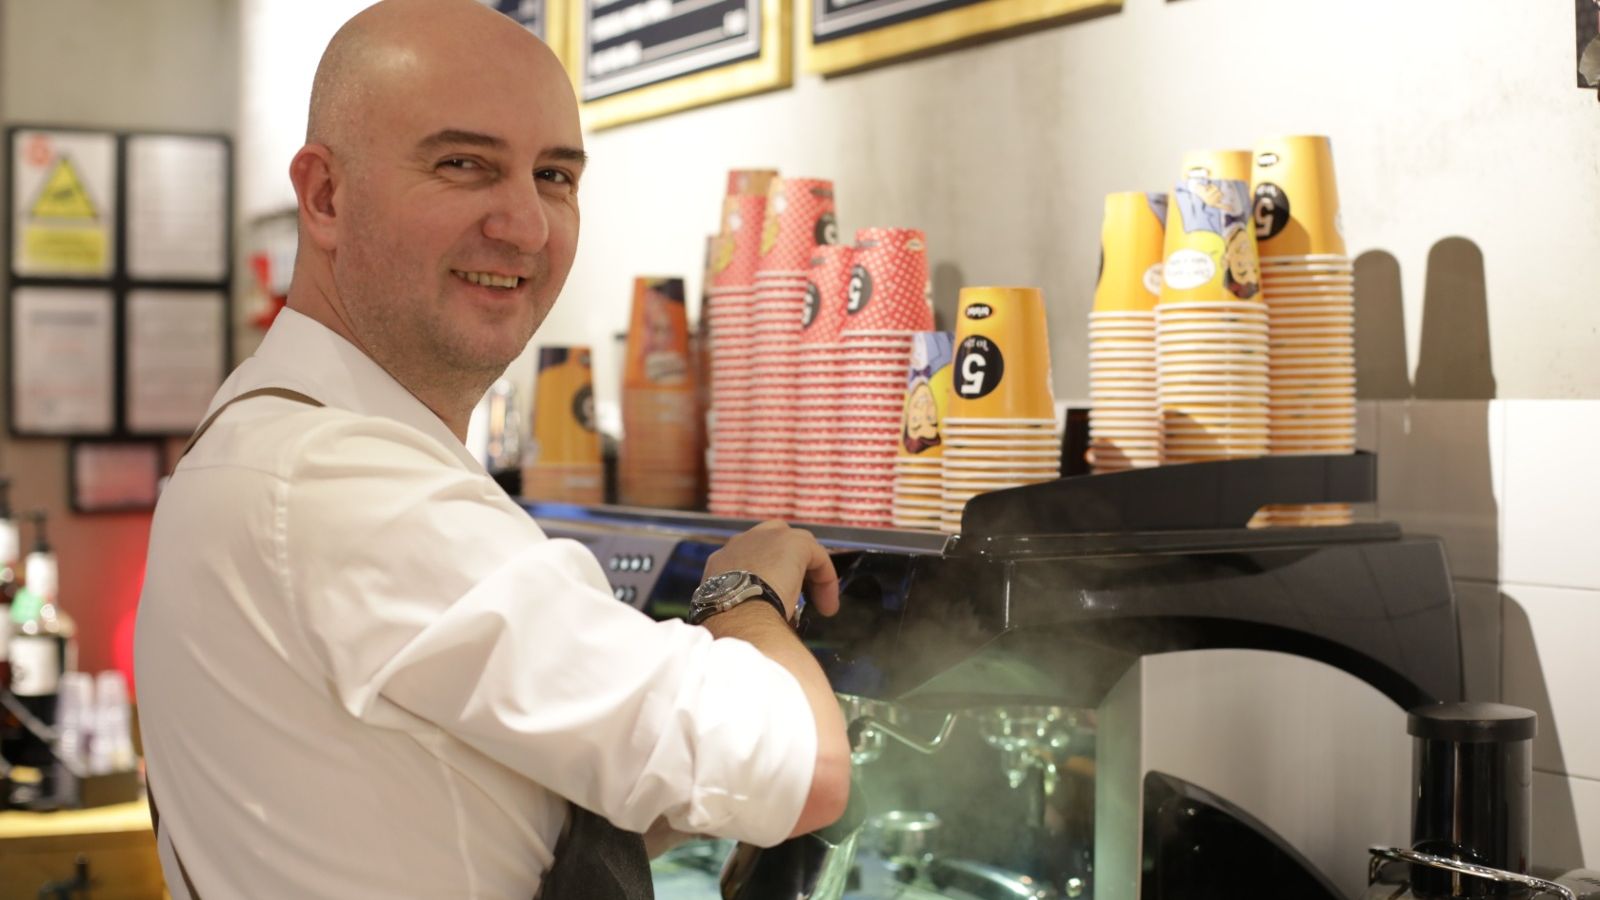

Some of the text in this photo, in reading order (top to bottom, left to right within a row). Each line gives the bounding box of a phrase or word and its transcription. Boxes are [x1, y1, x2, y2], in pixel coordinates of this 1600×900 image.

[1254, 197, 1275, 237] 5
[847, 277, 862, 310] 5
[961, 353, 987, 394] 5
